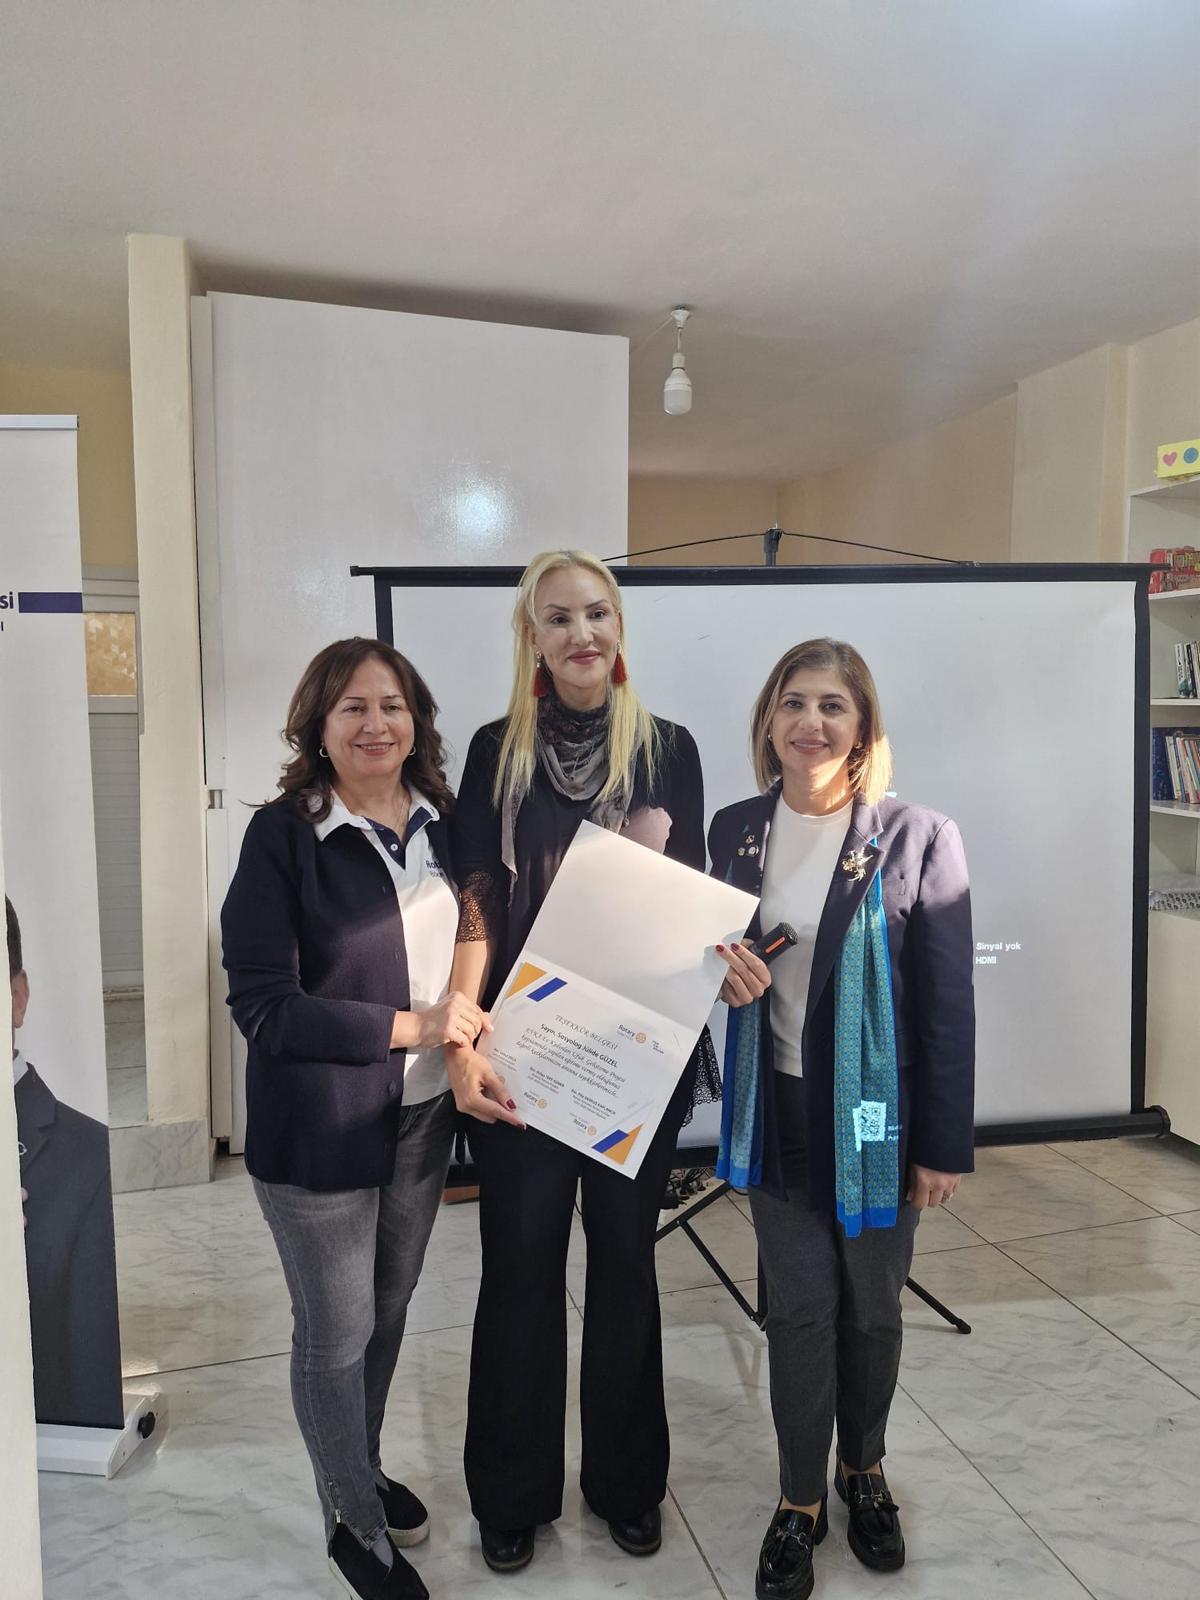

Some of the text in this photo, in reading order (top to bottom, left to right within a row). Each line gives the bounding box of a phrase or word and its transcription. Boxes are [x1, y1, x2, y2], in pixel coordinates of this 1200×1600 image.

[976, 941, 1022, 952] Sinyal yok
[975, 956, 997, 965] HDMI
[617, 1024, 635, 1037] Rotary
[556, 1031, 582, 1049] Sosyolog
